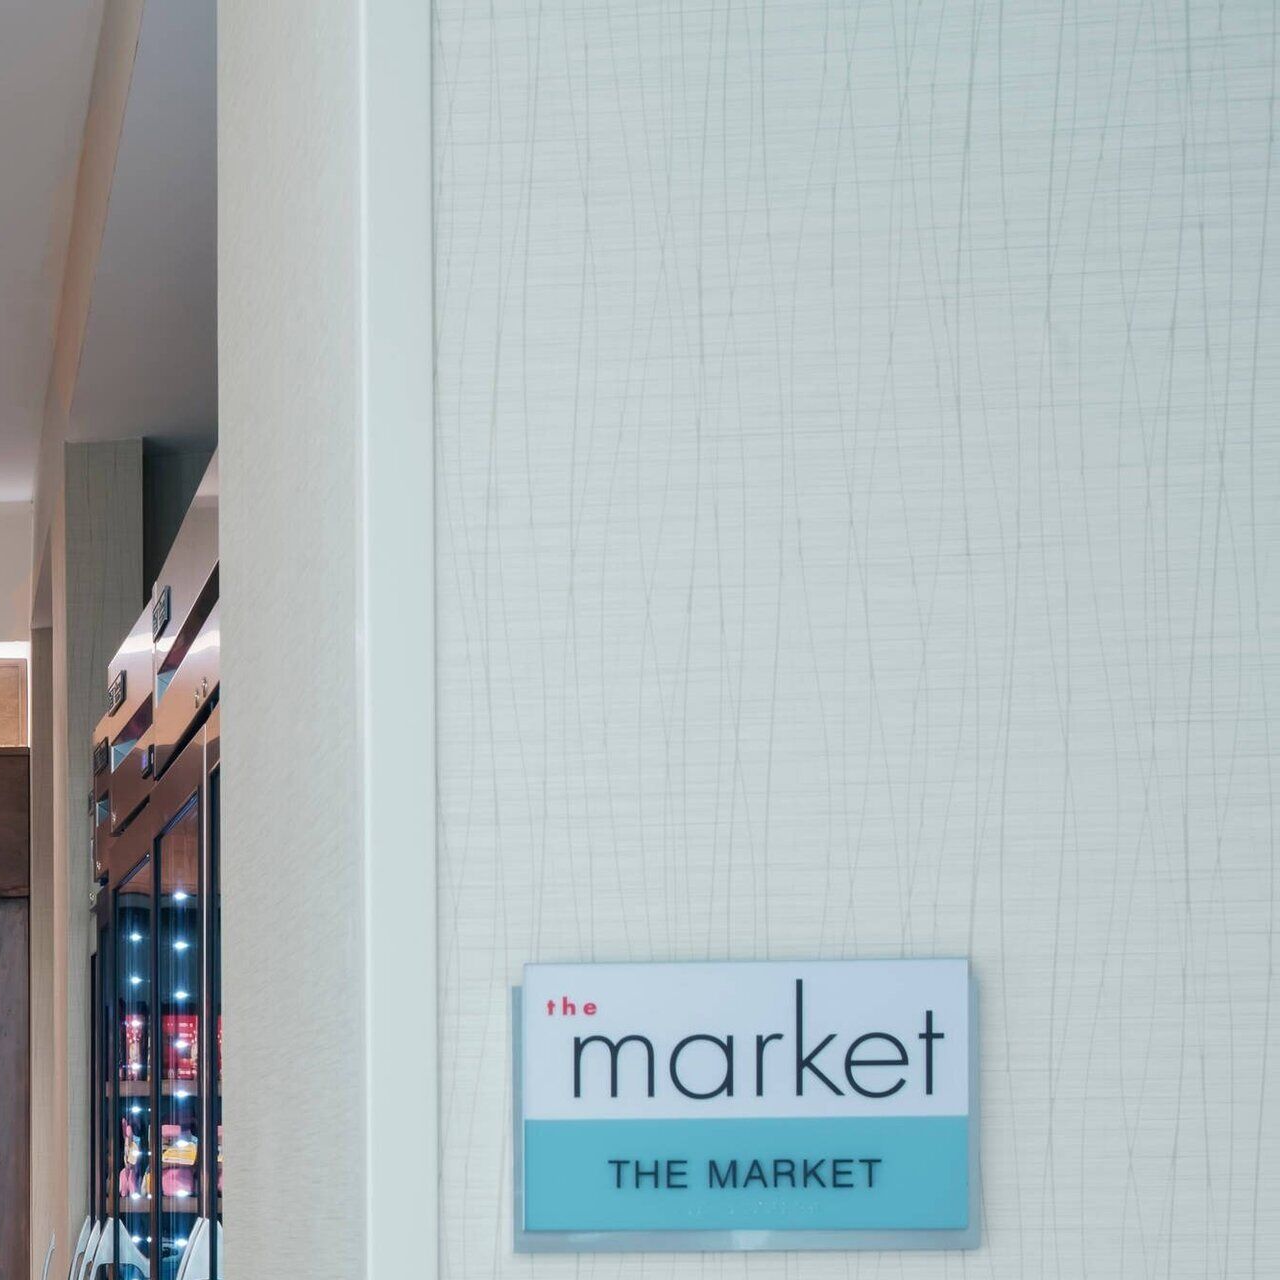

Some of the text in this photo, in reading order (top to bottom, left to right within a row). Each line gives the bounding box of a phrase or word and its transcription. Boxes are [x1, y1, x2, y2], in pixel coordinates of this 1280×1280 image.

[546, 996, 598, 1016] the
[572, 978, 945, 1100] market
[608, 1158, 883, 1189] THE MARKET
